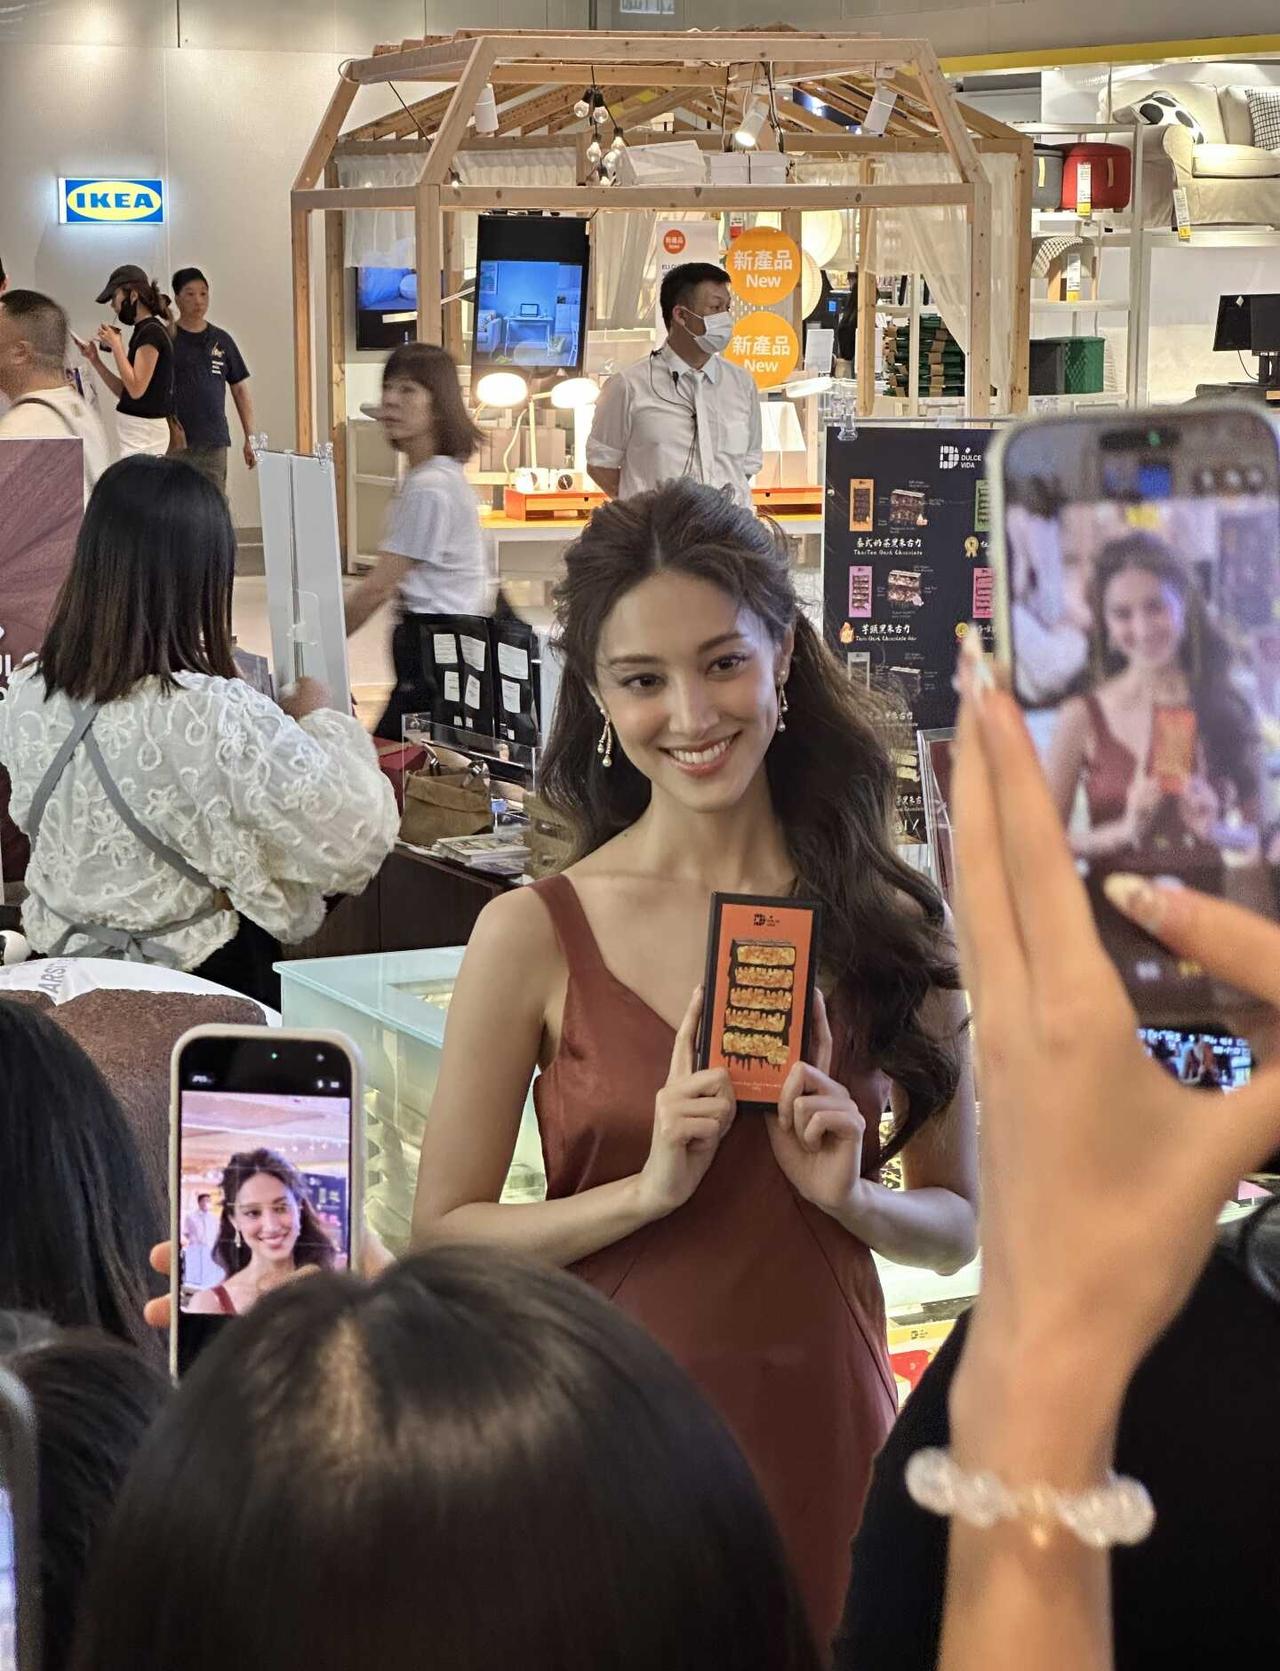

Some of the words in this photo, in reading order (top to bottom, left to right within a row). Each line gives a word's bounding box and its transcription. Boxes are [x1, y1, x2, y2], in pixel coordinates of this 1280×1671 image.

[76, 193, 154, 208] IKEA
[733, 250, 793, 271] 新產品
[746, 274, 782, 288] New
[732, 335, 791, 356] 新產品
[744, 359, 779, 373] New
[961, 454, 982, 462] DULCE
